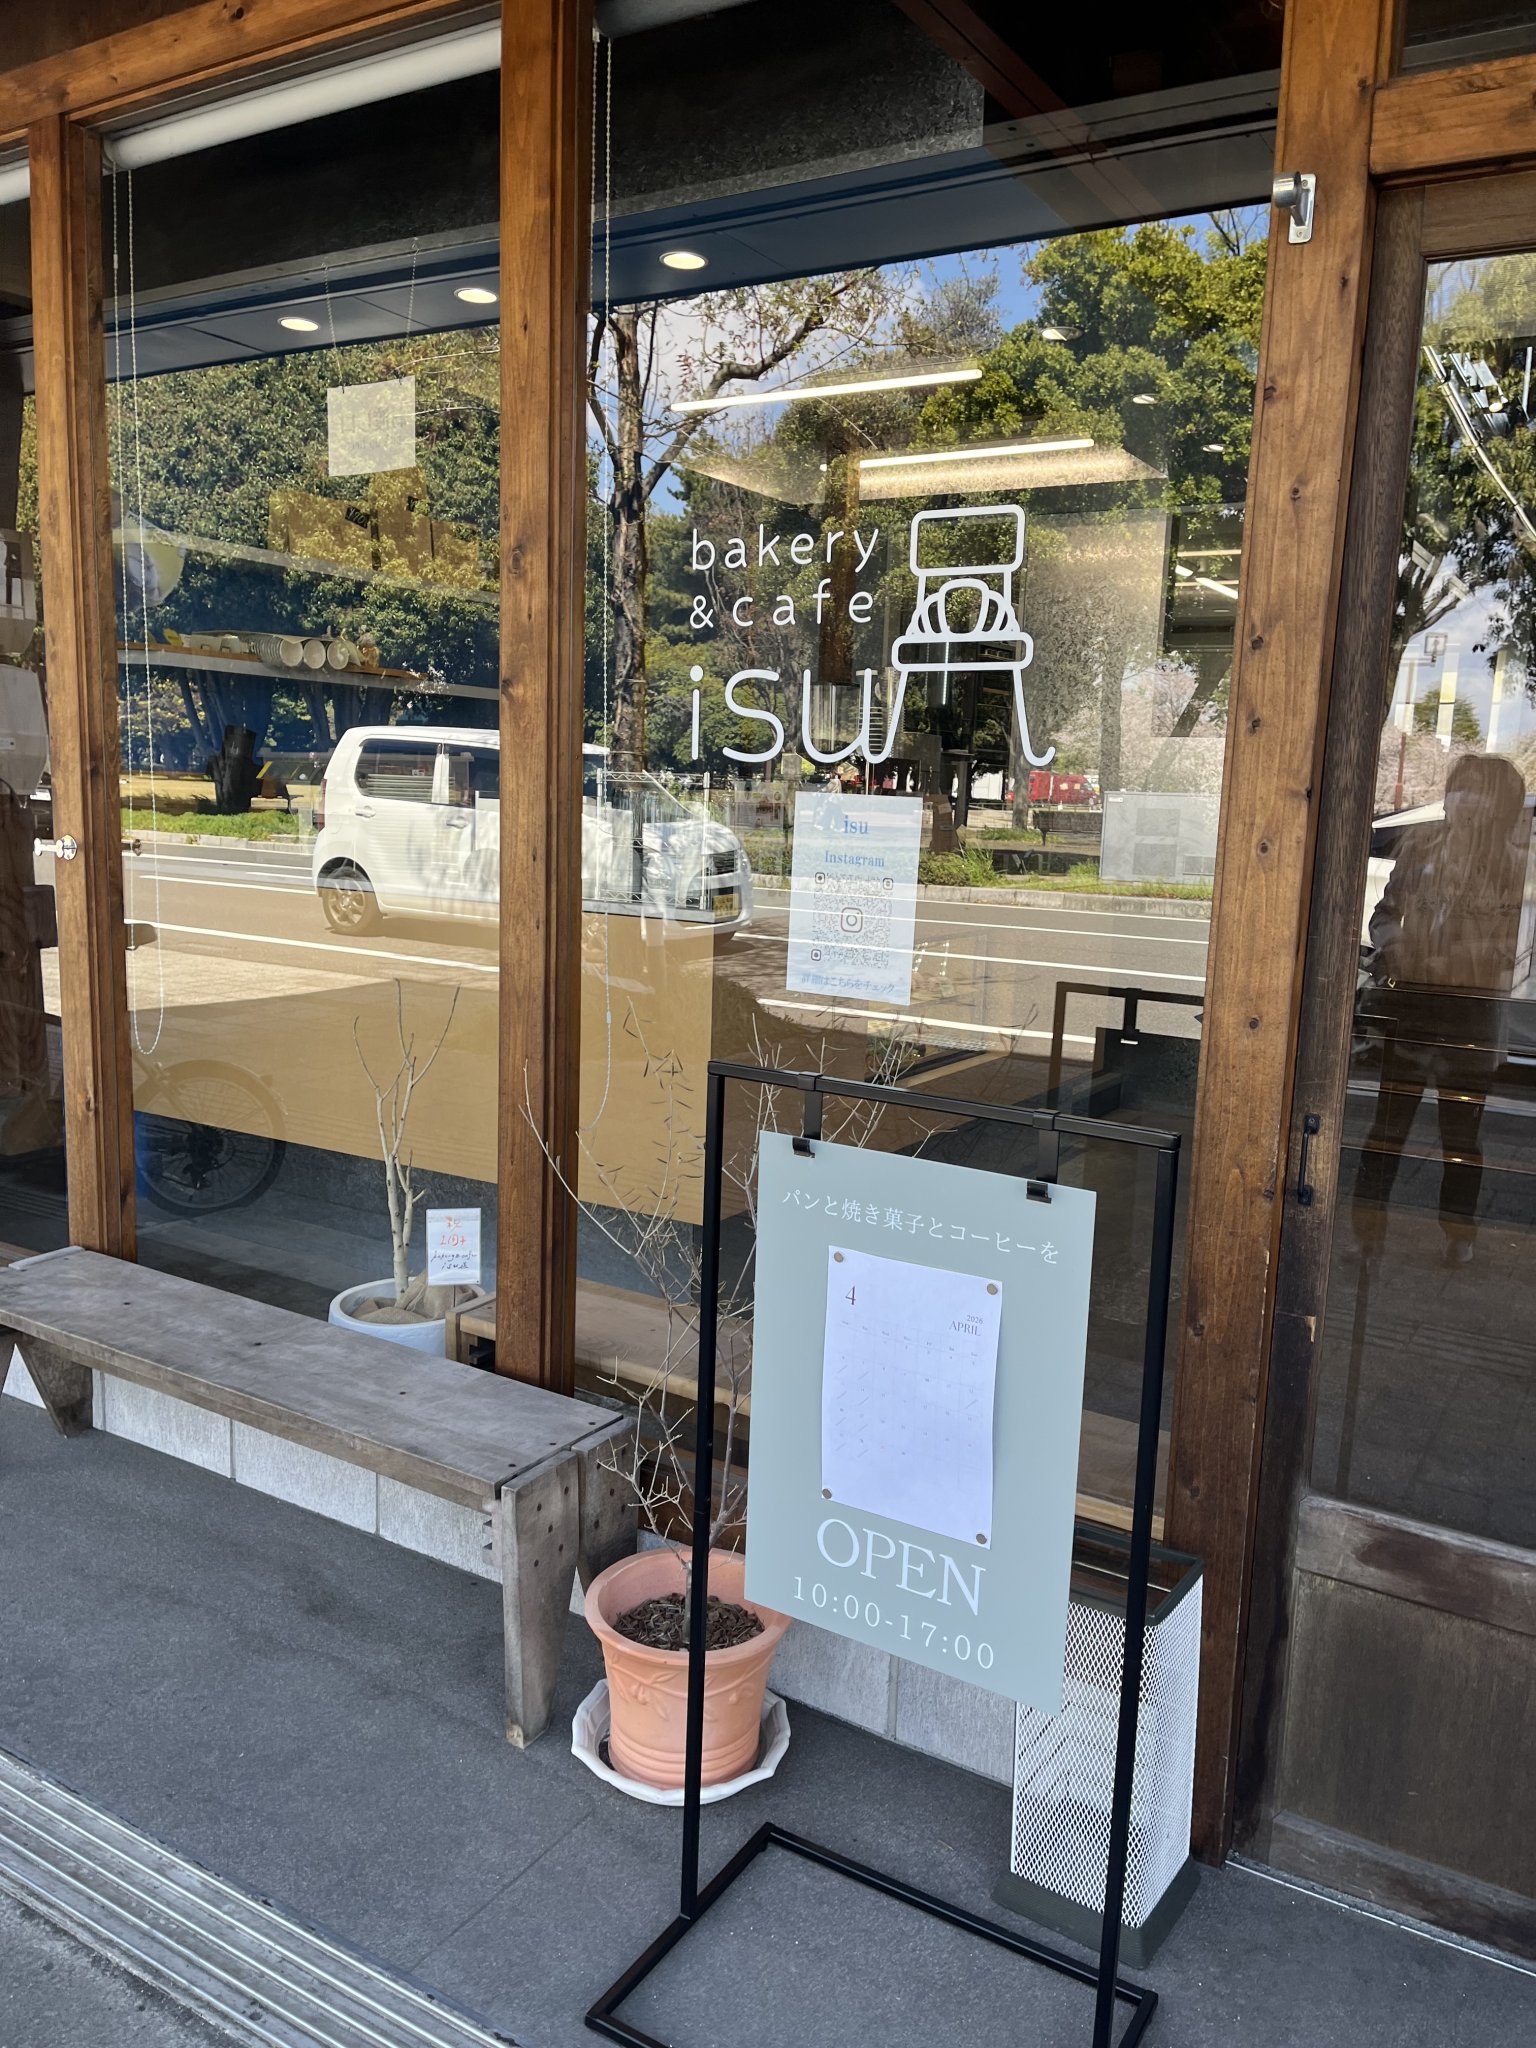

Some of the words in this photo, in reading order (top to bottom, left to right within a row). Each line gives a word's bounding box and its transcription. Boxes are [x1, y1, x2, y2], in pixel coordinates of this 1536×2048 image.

[691, 523, 880, 573] bakery
[689, 664, 893, 765] isu
[843, 815, 869, 836] isu
[824, 849, 885, 868] Instagram
[782, 1188, 1059, 1265] パンと焼き菓子とコーヒーを
[845, 1285, 857, 1306] 4
[948, 1320, 982, 1337] APRIL
[966, 1314, 984, 1325] 2026
[816, 1517, 987, 1617] OPEN
[793, 1576, 995, 1670] 10:00-17:00
